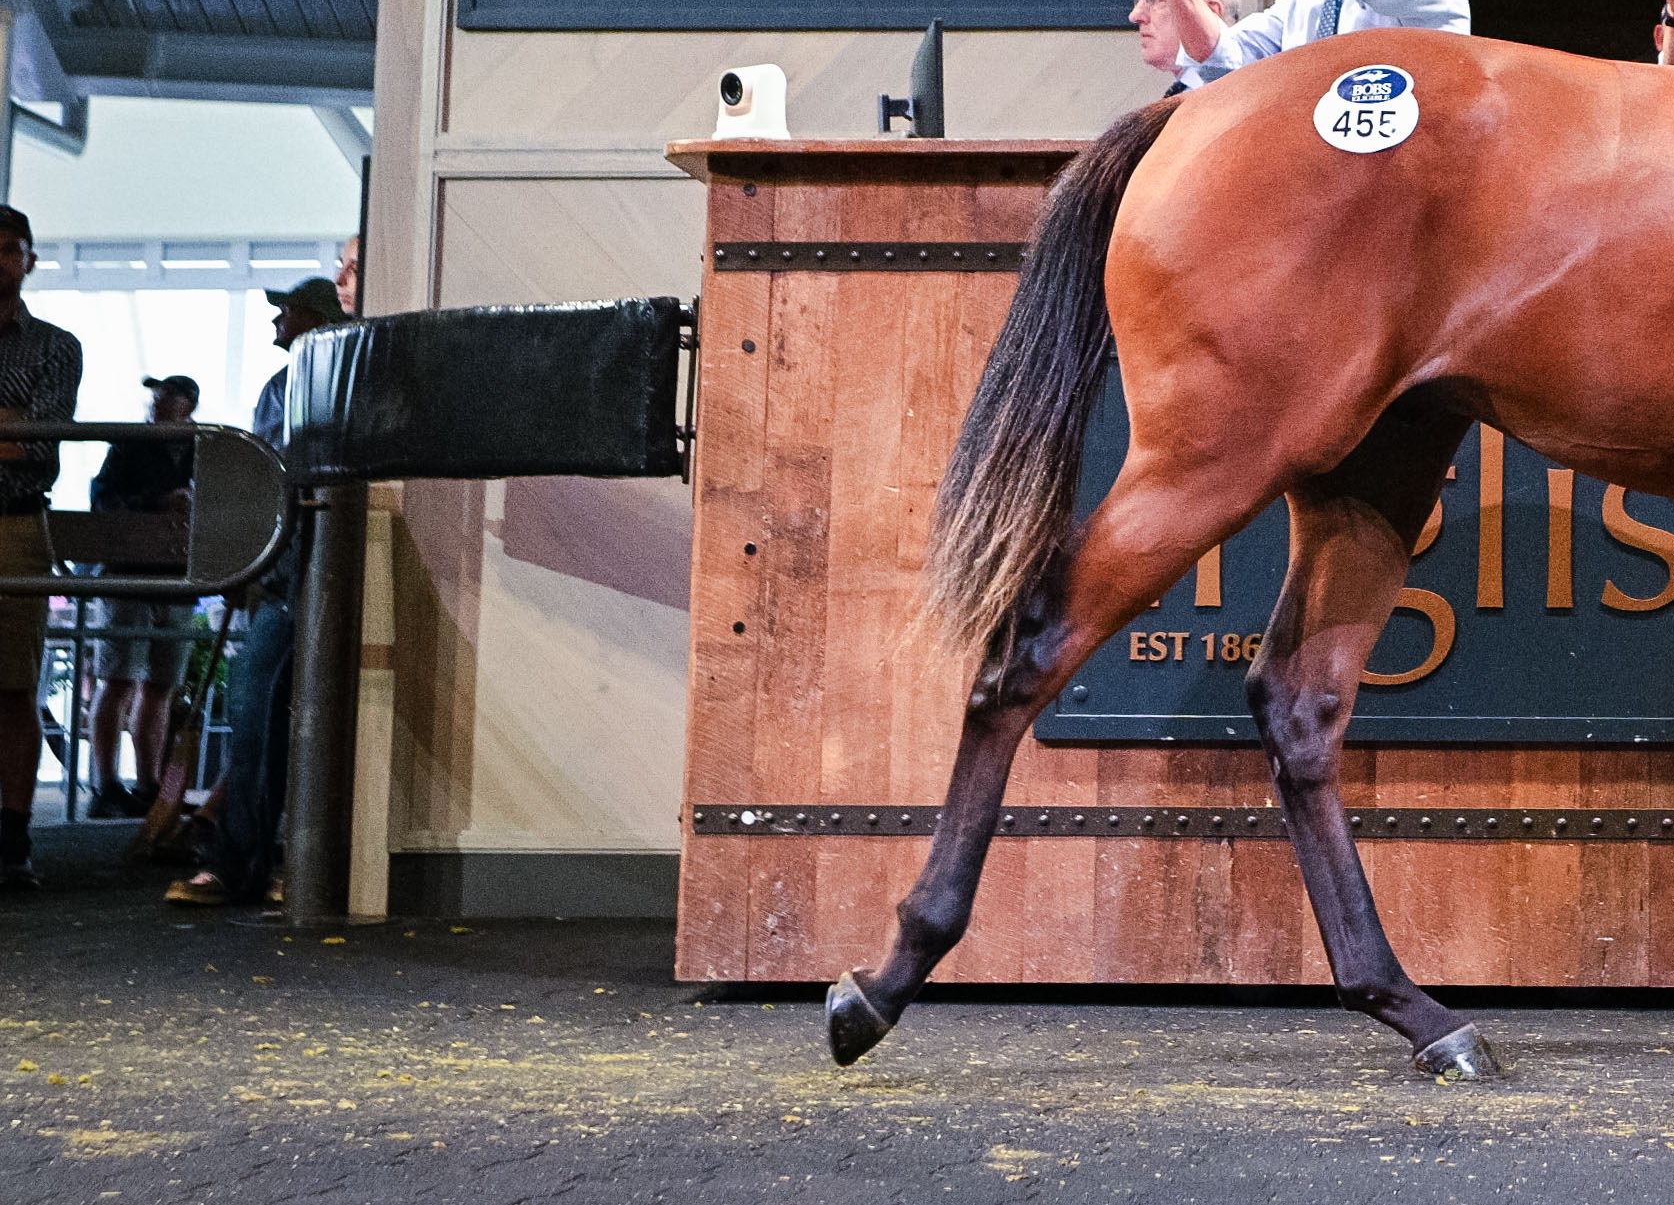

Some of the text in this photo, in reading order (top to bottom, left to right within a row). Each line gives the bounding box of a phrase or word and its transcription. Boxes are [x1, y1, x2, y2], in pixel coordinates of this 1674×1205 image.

[1351, 82, 1392, 96] BOBS
[1332, 109, 1396, 138] 455
[1128, 630, 1190, 662] EST
